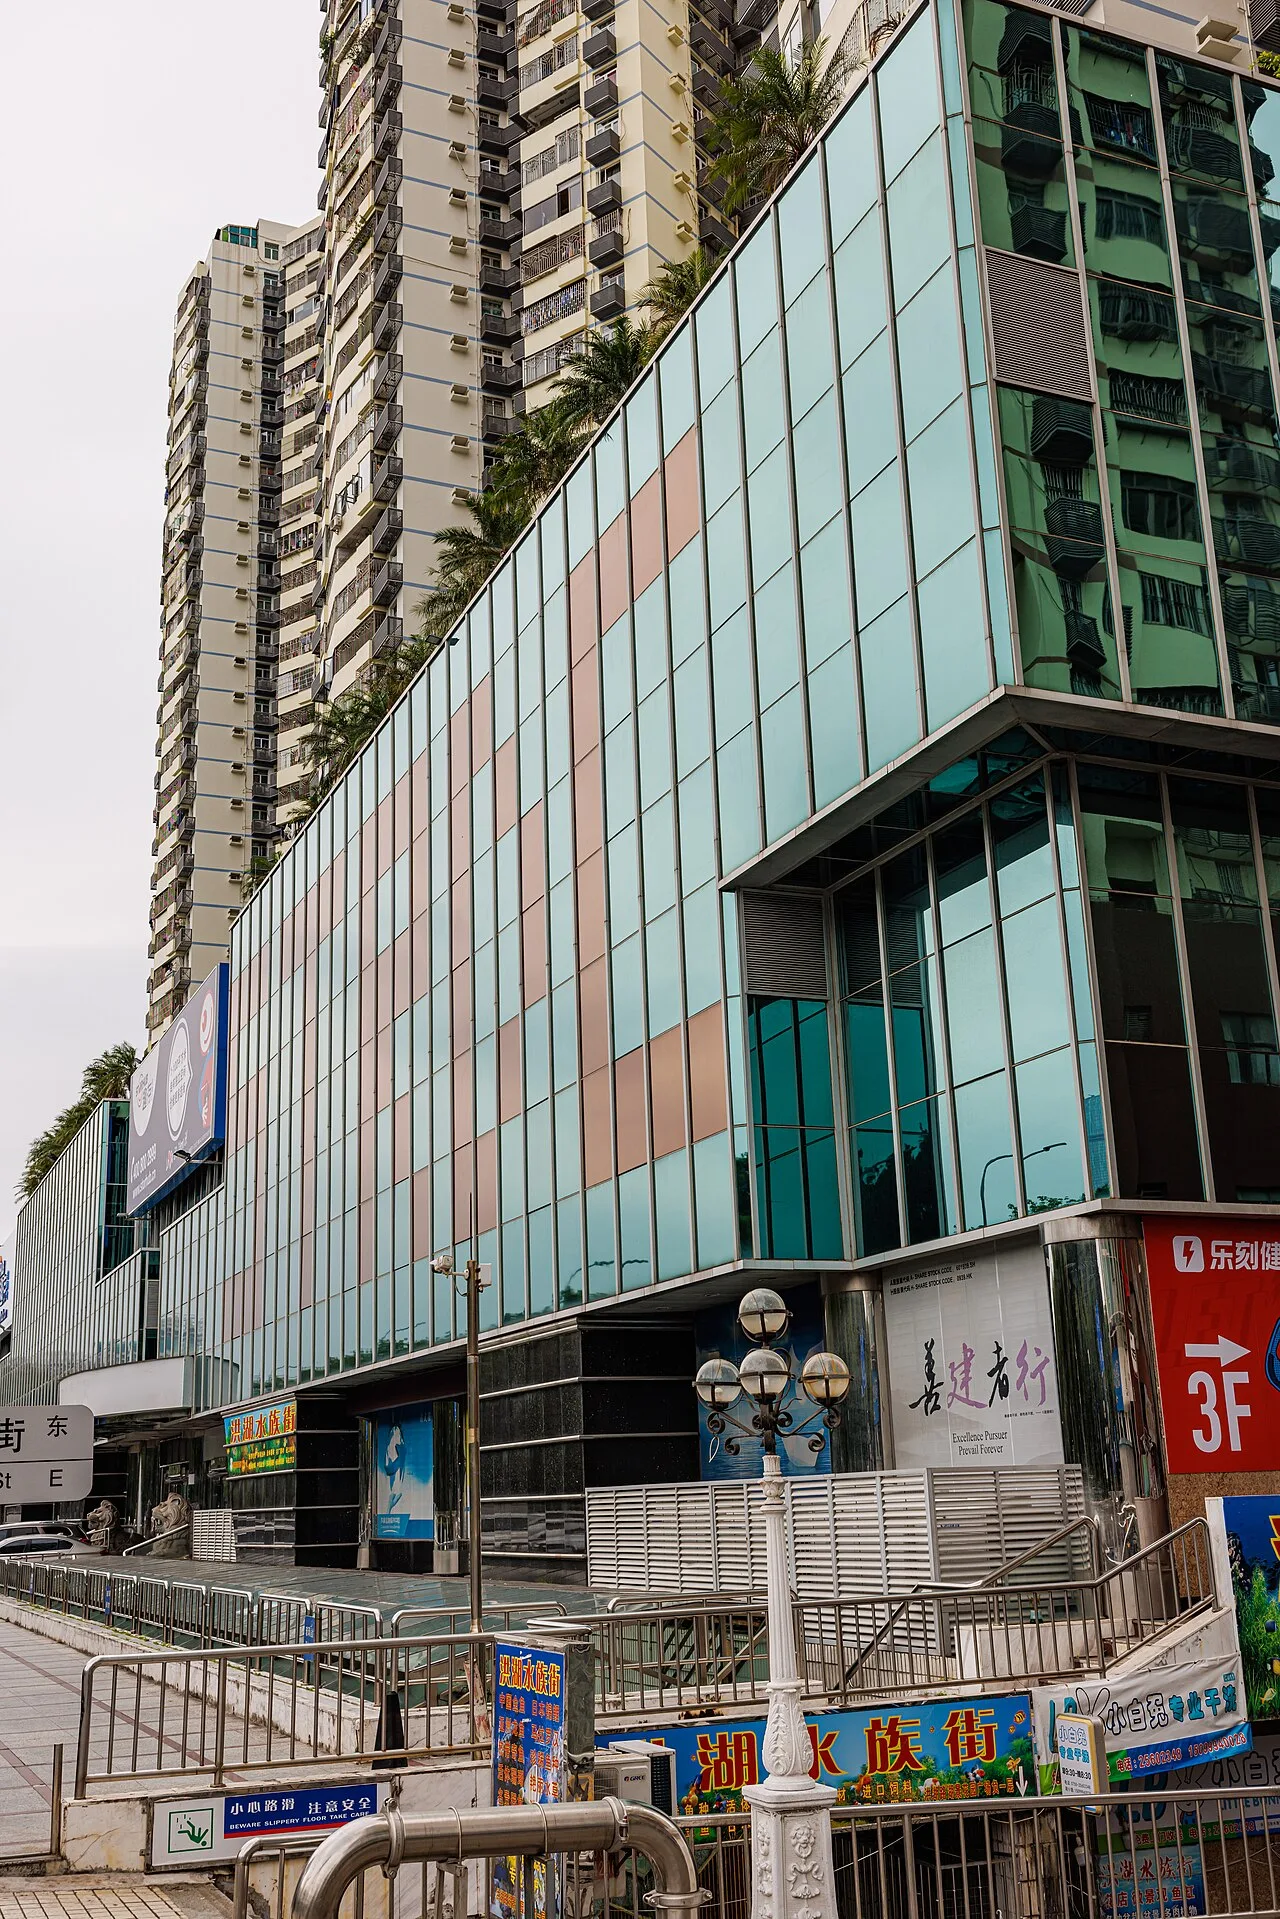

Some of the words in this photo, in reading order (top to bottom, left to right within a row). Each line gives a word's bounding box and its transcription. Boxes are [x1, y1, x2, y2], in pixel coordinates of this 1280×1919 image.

[909, 1338, 1050, 1416] 善建者行
[1187, 1371, 1251, 1453] 3F
[0, 1418, 25, 1453] 街
[47, 1415, 68, 1437] 东
[230, 1404, 295, 1445] 洪湖水族街
[952, 1431, 984, 1443] Excellence
[984, 1430, 1008, 1441] Pursuer
[958, 1445, 979, 1456] Prevail
[980, 1444, 1004, 1455] Forever
[50, 1469, 63, 1487] E
[499, 1655, 560, 1698] 洪湖水族街
[499, 1692, 526, 1714] 中国金鱼
[230, 1798, 295, 1815] 小心路滑
[308, 1797, 371, 1815] 注意安全
[229, 1821, 261, 1830] BEWARE
[264, 1818, 300, 1827] SLIPPERY
[302, 1815, 327, 1823] FLOOR
